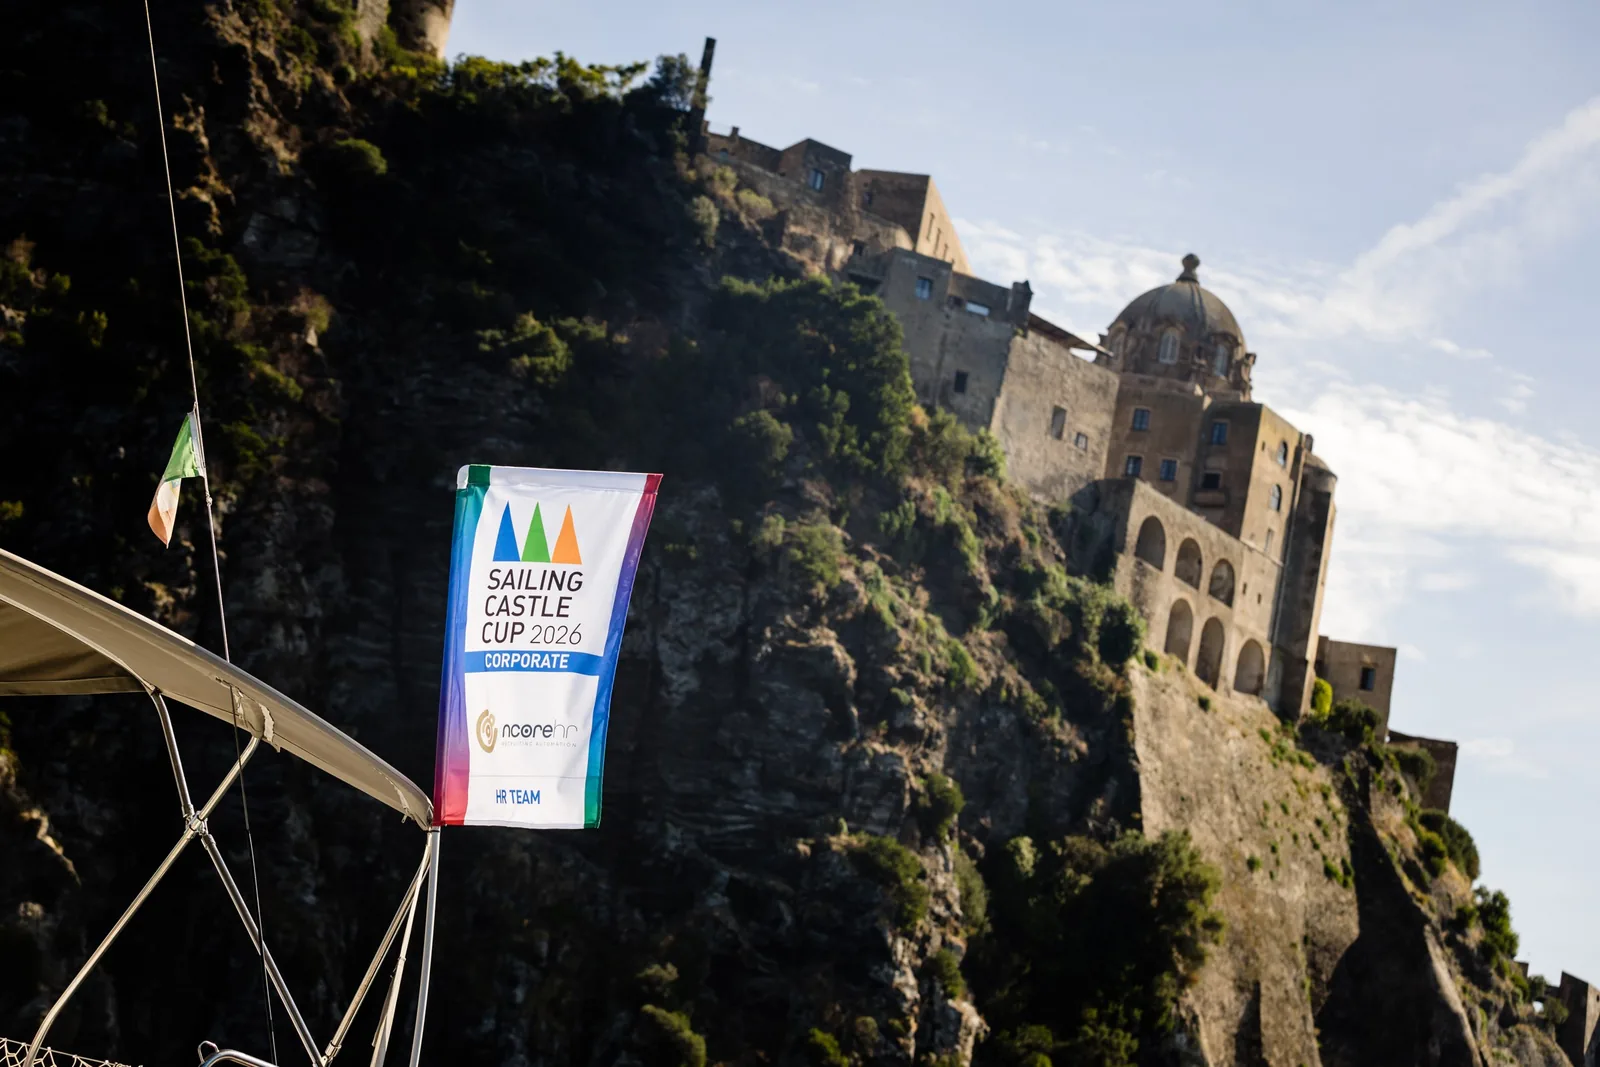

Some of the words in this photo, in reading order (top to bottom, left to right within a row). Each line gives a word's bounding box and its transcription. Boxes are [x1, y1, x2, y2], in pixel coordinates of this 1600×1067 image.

[487, 568, 583, 592] SAILING
[485, 595, 573, 618] CASTLE
[482, 621, 525, 644] CUP
[530, 623, 582, 645] 2026
[485, 652, 570, 669] CORPORATE
[495, 789, 507, 804] HR
[509, 789, 541, 805] TEAM
